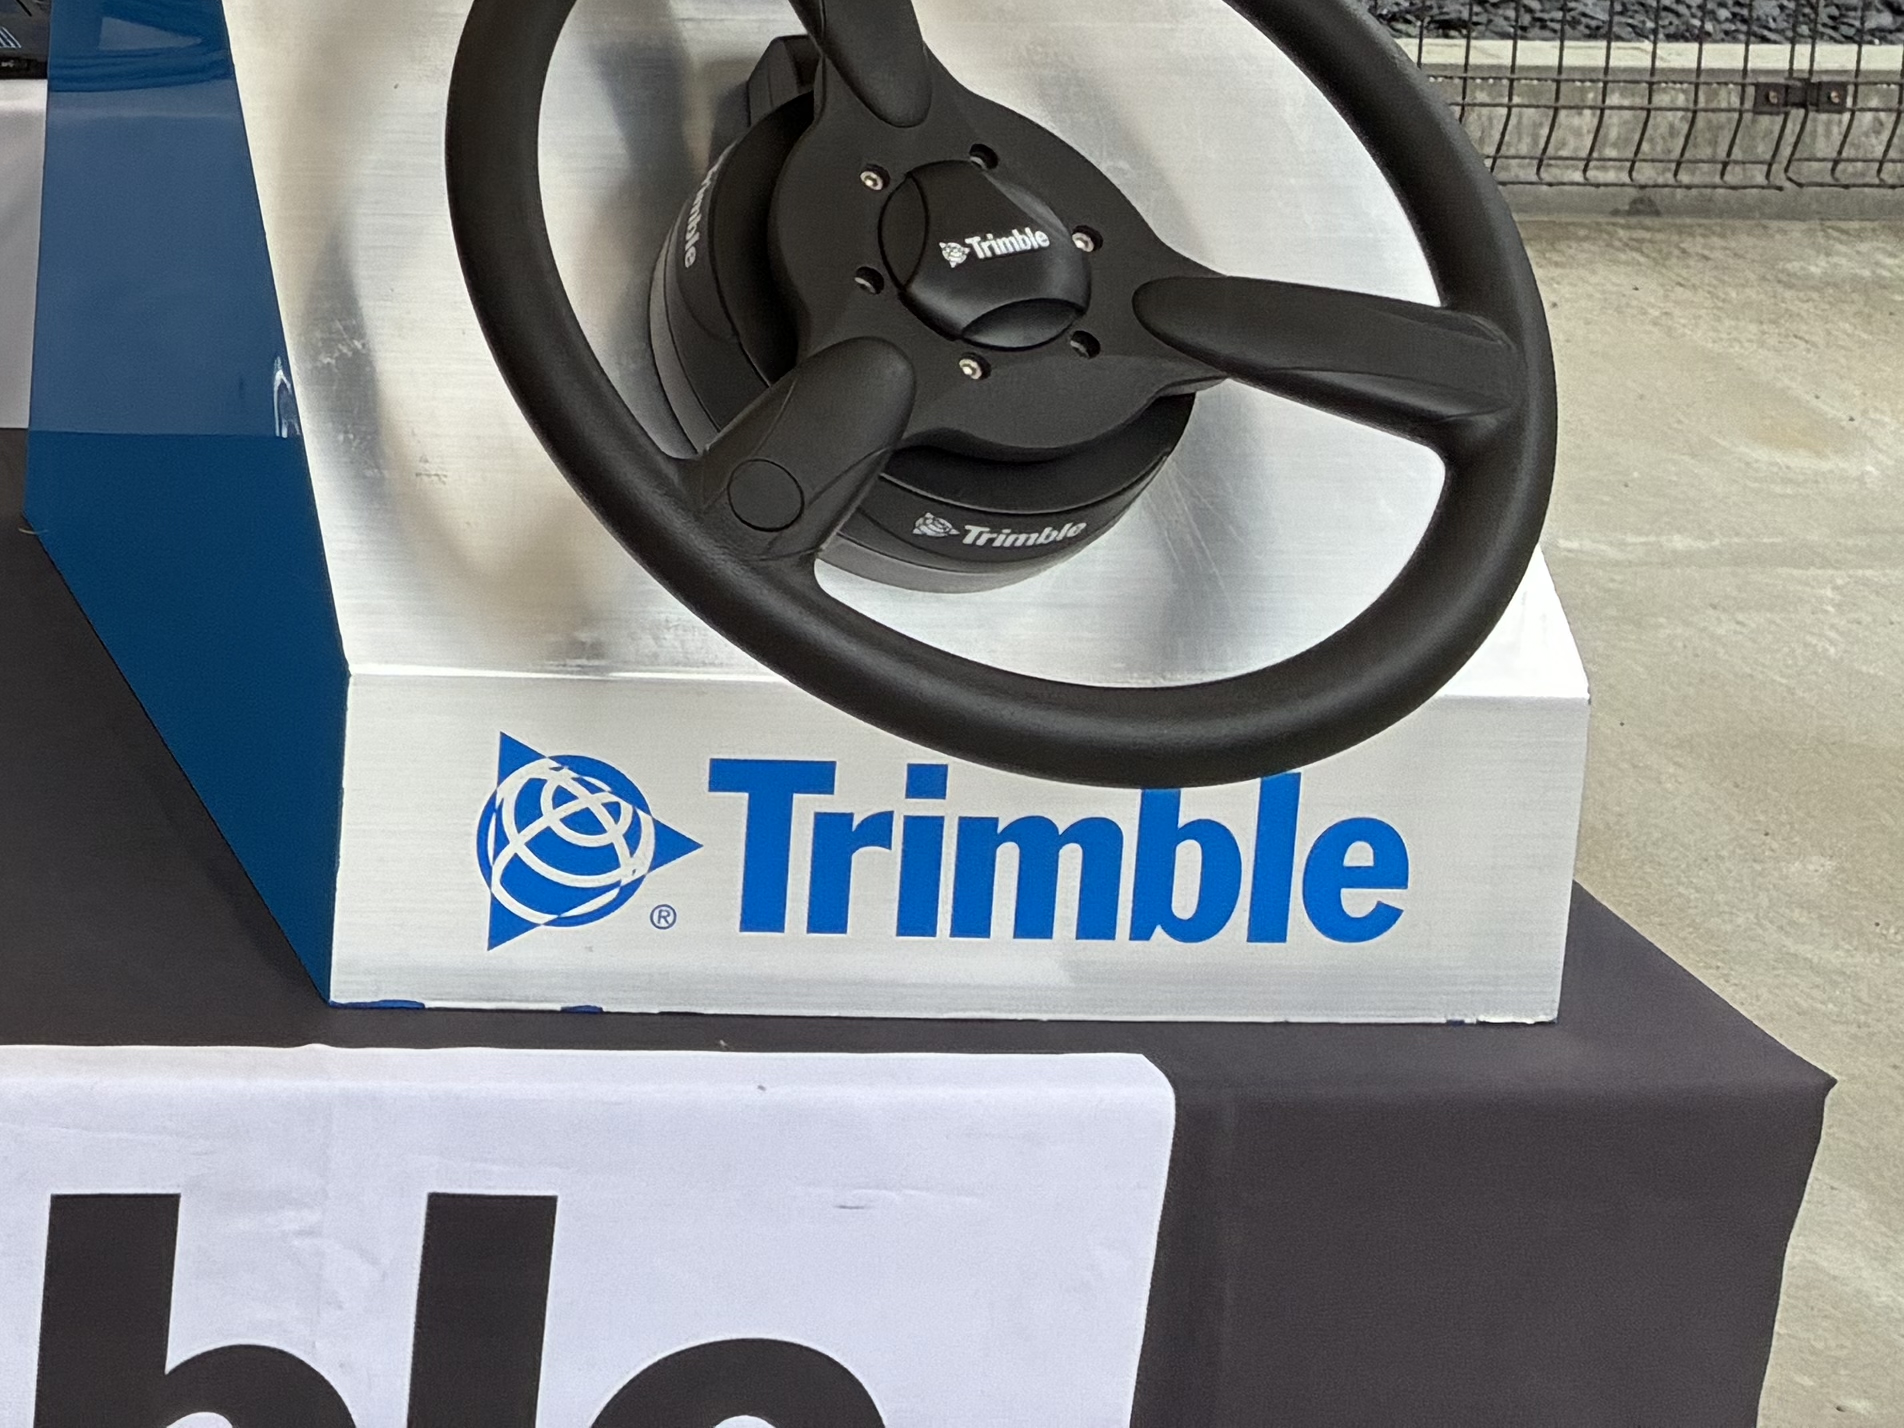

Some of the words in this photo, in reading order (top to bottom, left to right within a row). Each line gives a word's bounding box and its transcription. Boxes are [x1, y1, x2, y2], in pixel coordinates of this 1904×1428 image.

[965, 226, 1051, 260] Trimble
[962, 520, 1088, 549] Trimble
[708, 757, 1410, 944] Trimble
